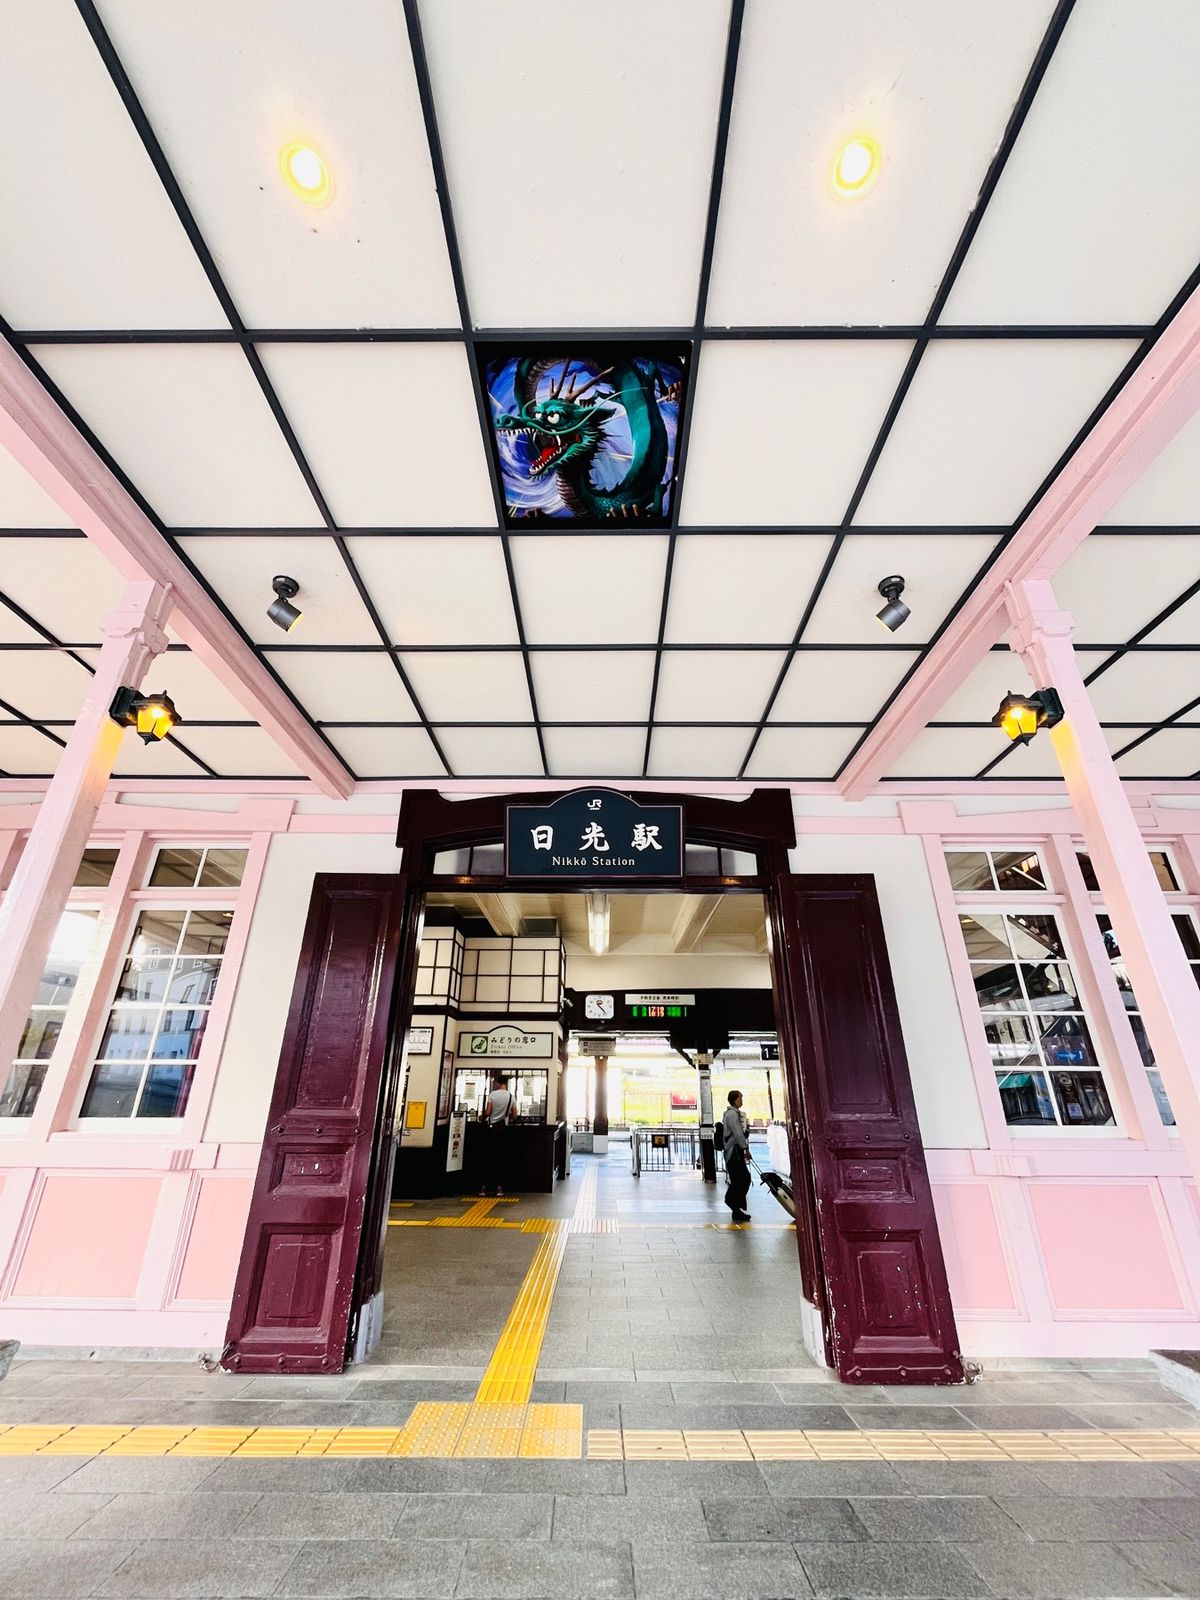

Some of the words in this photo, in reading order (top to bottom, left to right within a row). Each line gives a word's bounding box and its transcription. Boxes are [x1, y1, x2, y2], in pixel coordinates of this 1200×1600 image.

[587, 799, 602, 808] JR
[530, 822, 663, 851] 日光駅
[592, 857, 635, 865] Station
[491, 1036, 536, 1044] みどりの窓口
[764, 1047, 769, 1059] 1
